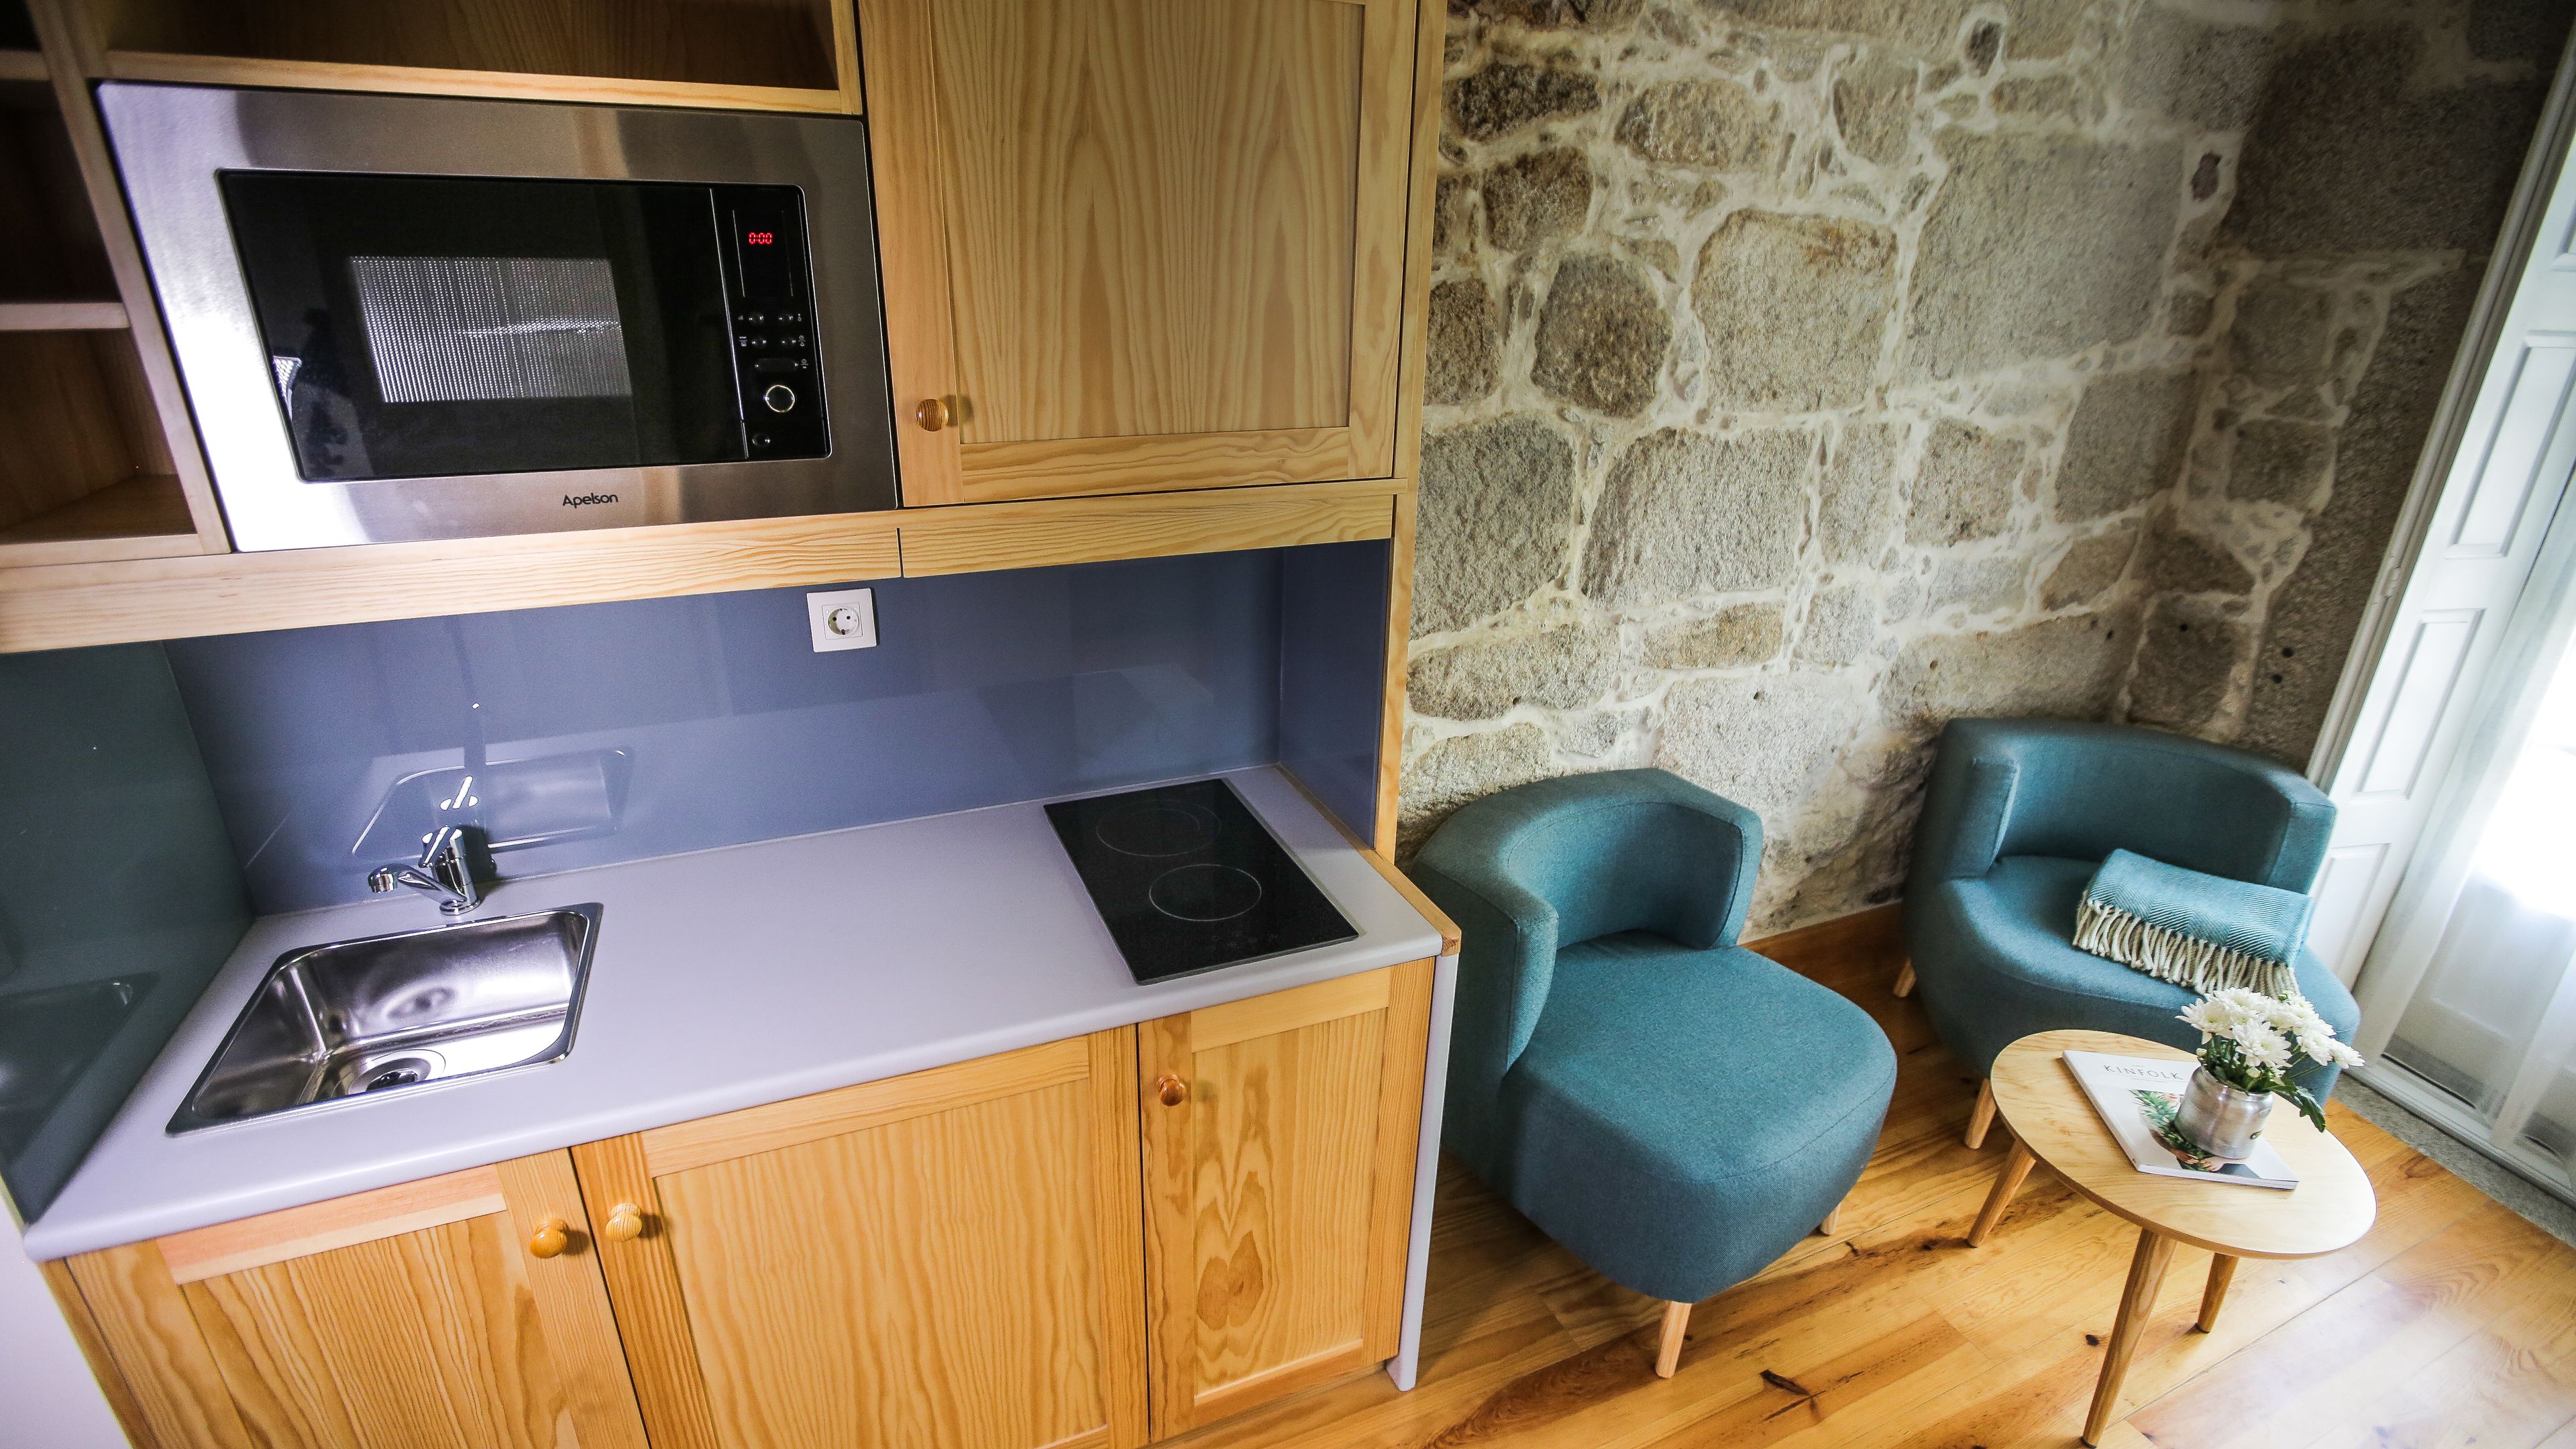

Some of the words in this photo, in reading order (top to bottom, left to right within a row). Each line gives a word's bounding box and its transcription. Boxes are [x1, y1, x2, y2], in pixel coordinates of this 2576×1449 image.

[749, 232, 773, 244] 0:00
[562, 492, 619, 508] Apelson
[2104, 1065, 2184, 1080] KINFOLK
